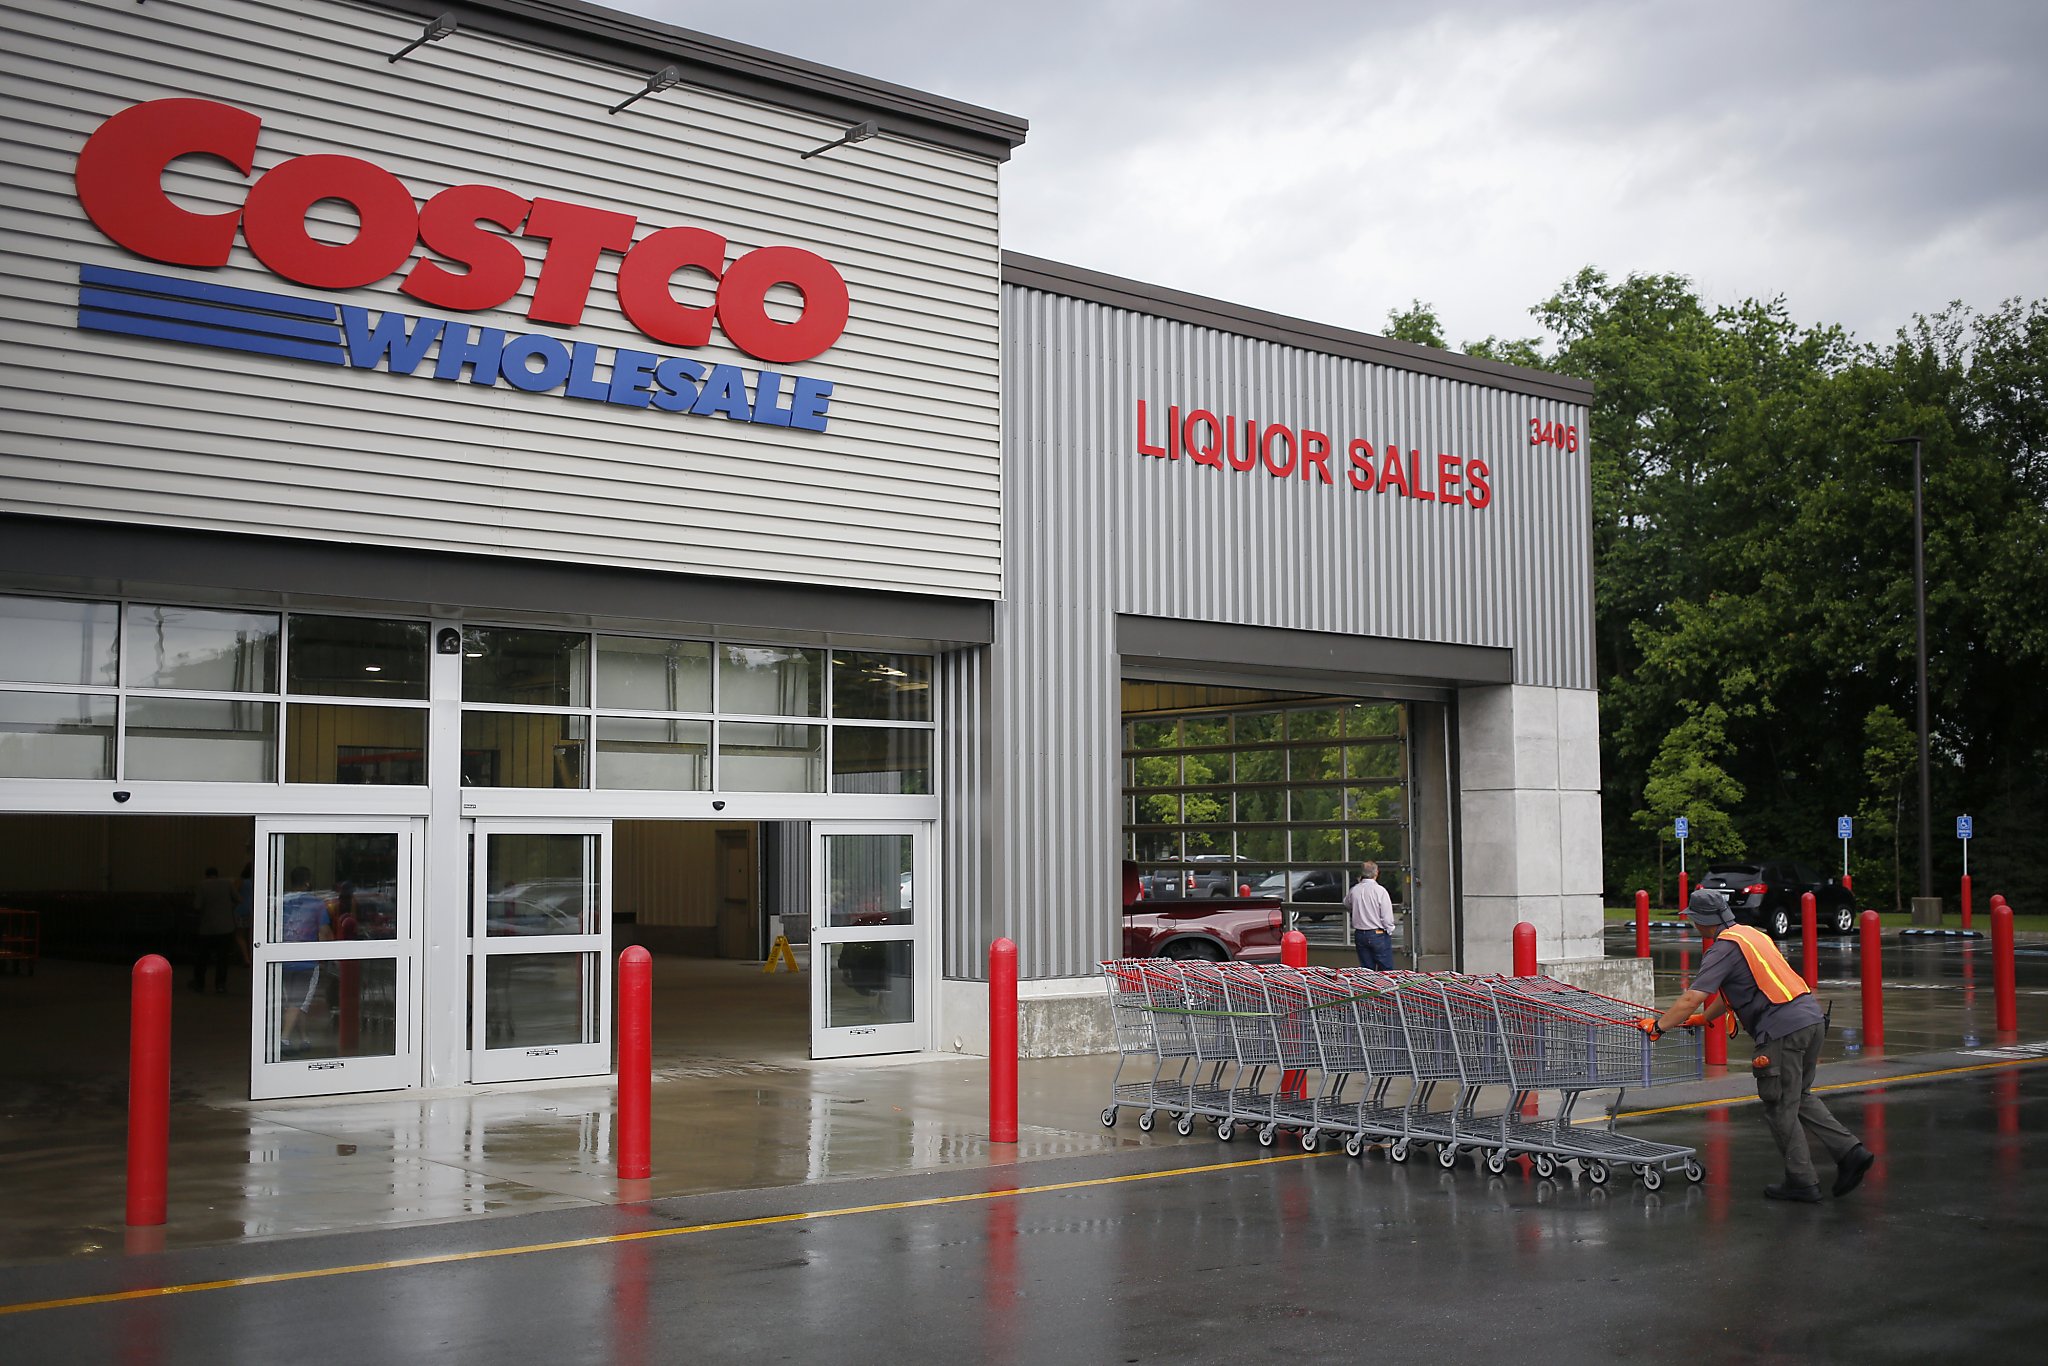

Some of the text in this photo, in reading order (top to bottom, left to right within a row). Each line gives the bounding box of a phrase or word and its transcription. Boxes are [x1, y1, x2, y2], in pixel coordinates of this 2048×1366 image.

[75, 97, 850, 363] COSTCO
[339, 304, 834, 433] WHOLESALE
[1137, 399, 1492, 509] LIQUOR SALES
[1530, 417, 1579, 453] 3406
